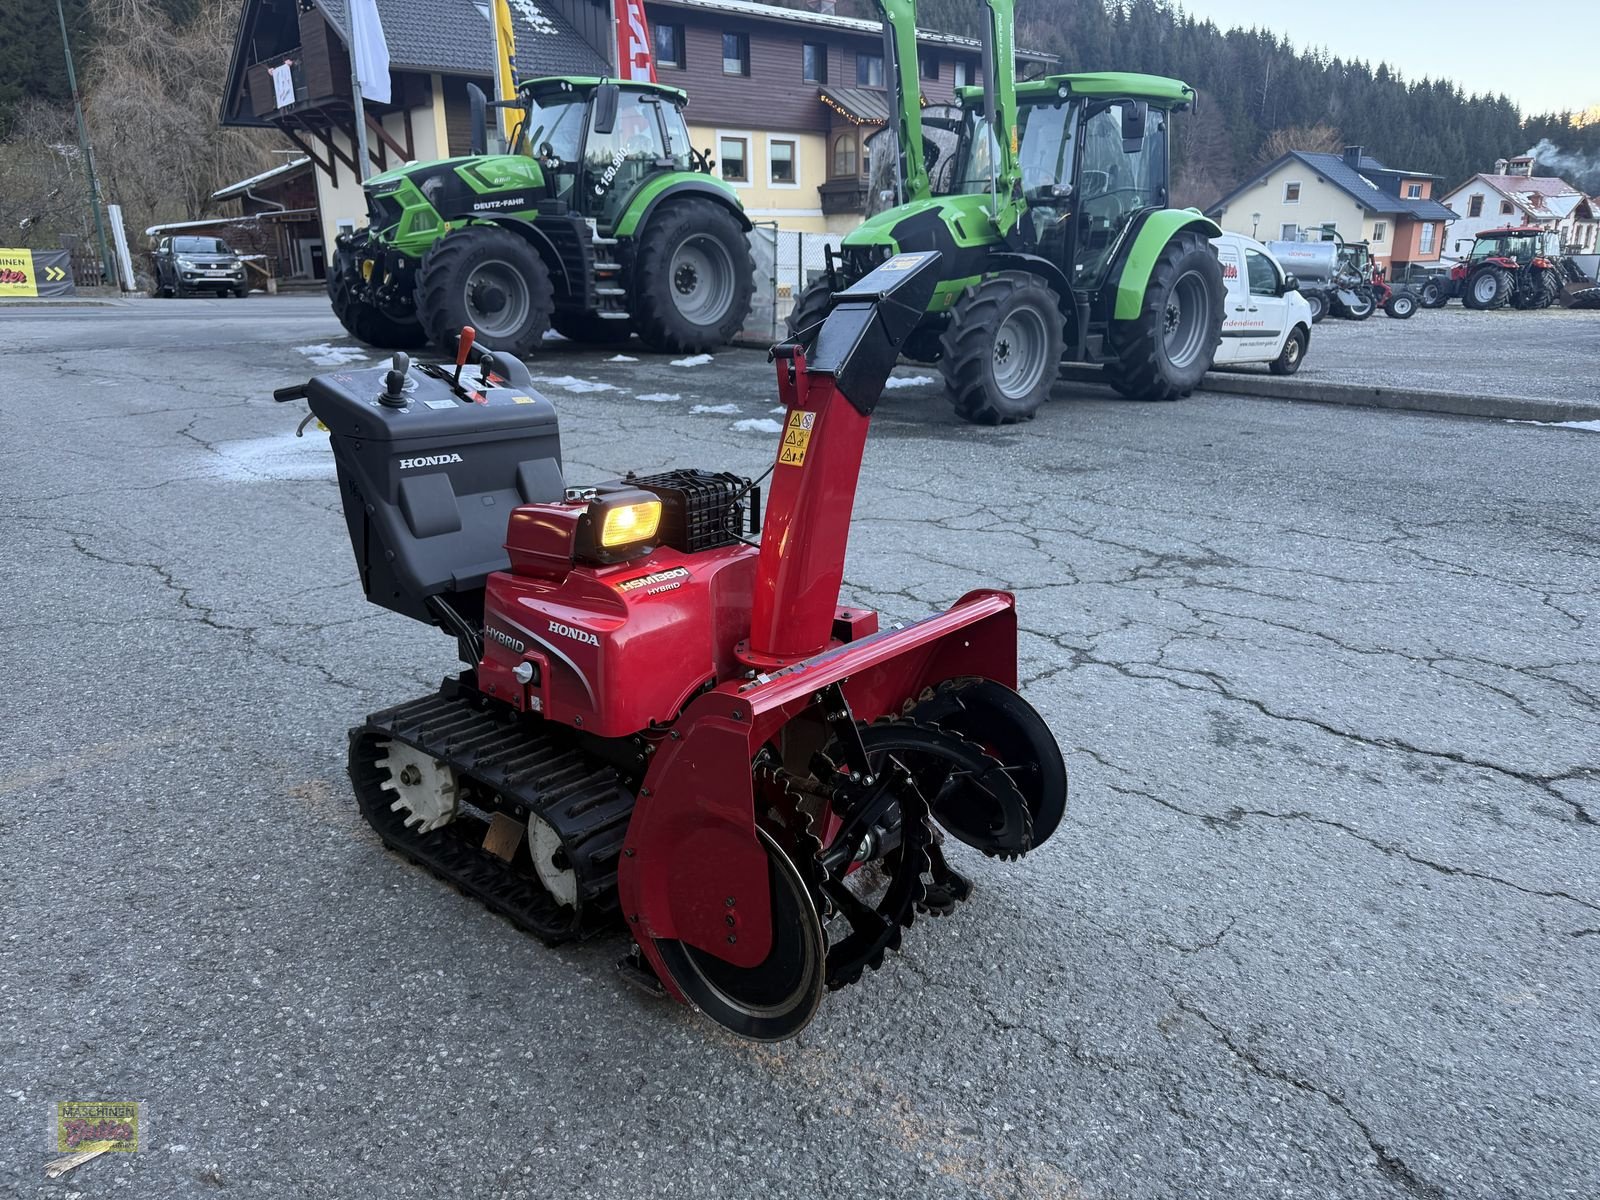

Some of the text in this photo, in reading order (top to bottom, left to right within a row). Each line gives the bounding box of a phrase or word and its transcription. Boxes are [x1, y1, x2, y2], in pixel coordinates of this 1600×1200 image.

[594, 184, 605, 196] €
[473, 198, 525, 211] DEUTZ-FAHR
[399, 453, 464, 469] HONDA
[647, 582, 681, 596] HYBRID
[486, 624, 526, 654] HYBRID
[547, 620, 600, 647] HONDA
